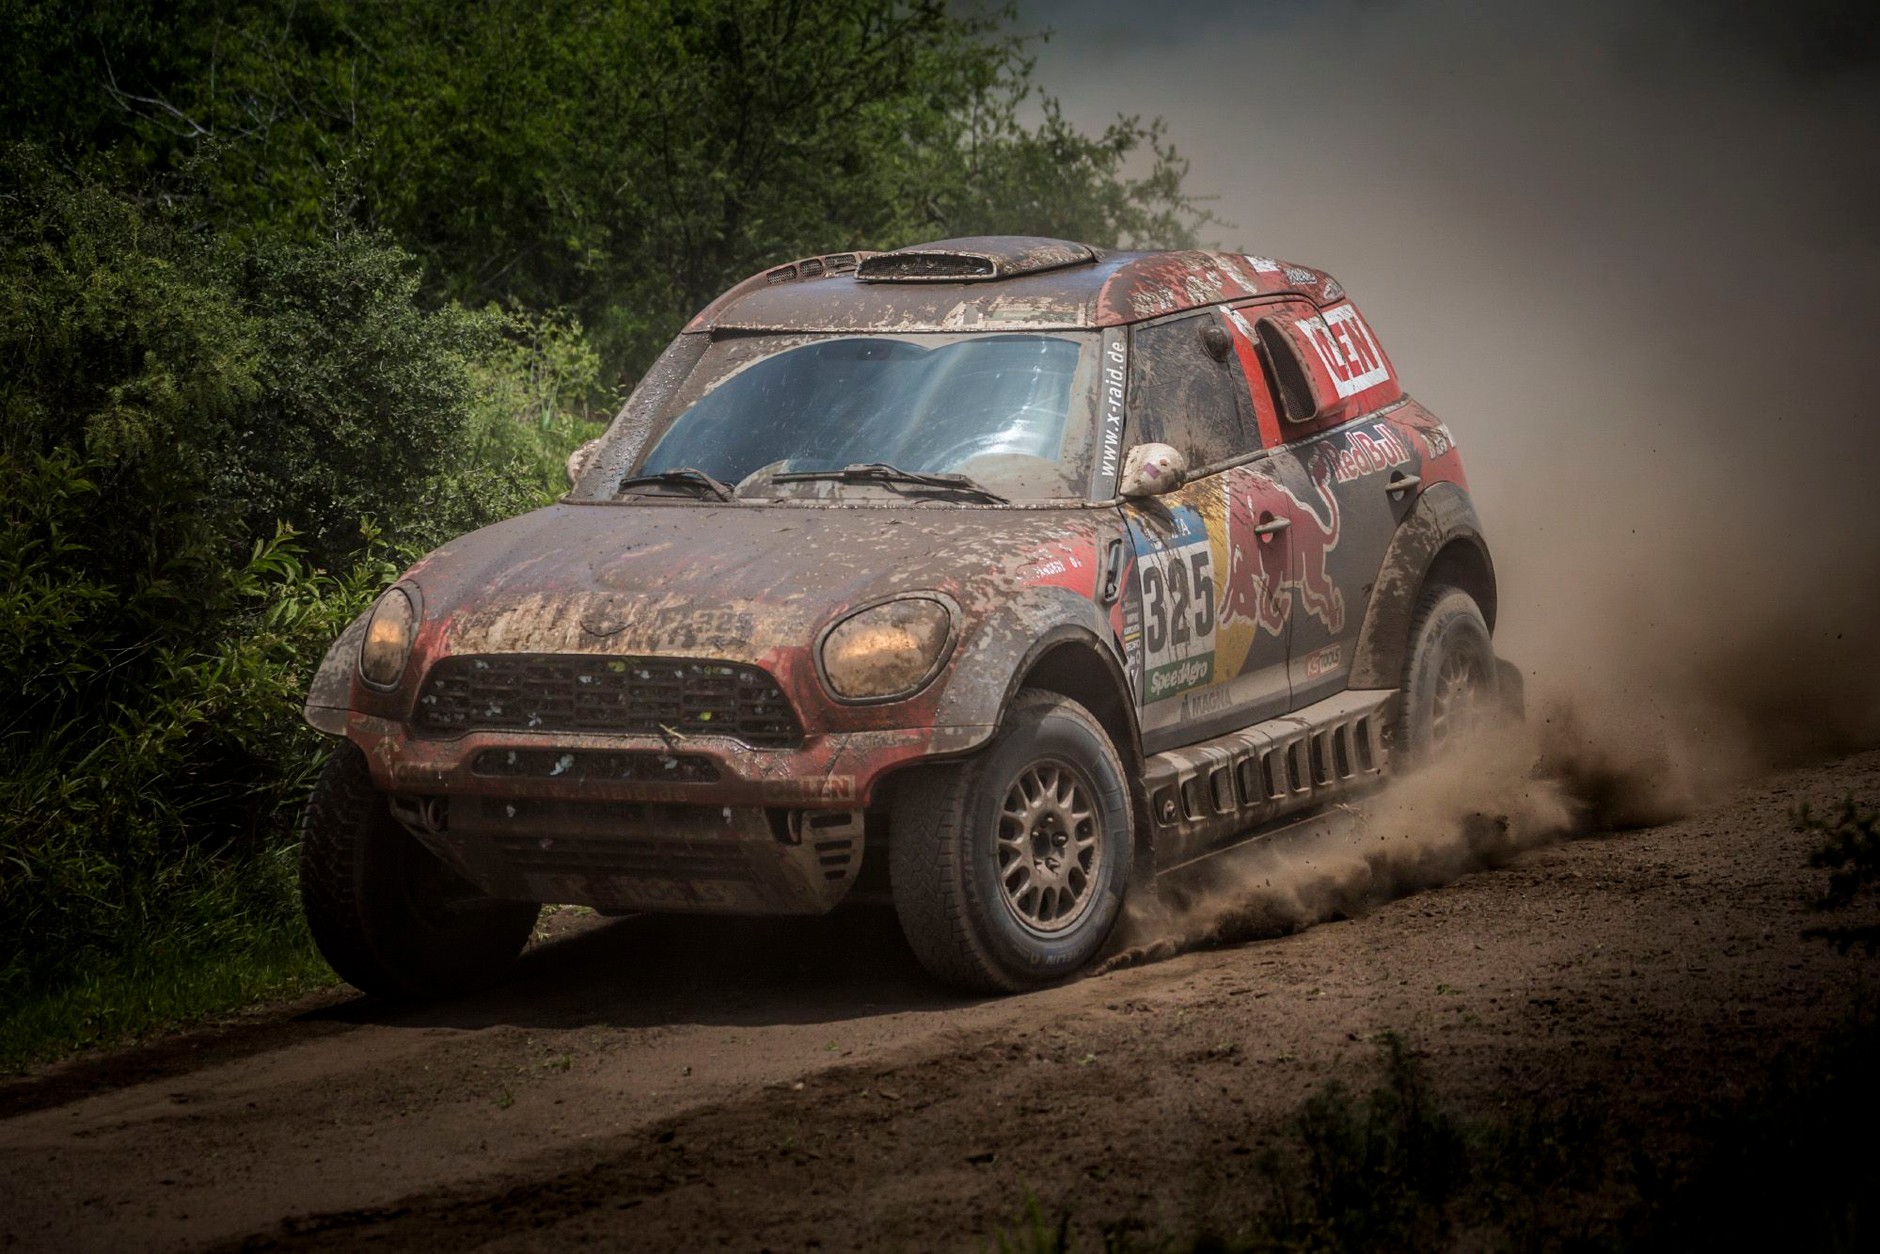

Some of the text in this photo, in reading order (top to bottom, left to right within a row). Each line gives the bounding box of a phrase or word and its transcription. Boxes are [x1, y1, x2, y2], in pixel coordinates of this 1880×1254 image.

[1101, 341, 1125, 477] www.x-raid.de
[1143, 551, 1214, 654] 325
[1151, 660, 1208, 695] SpeedAgro
